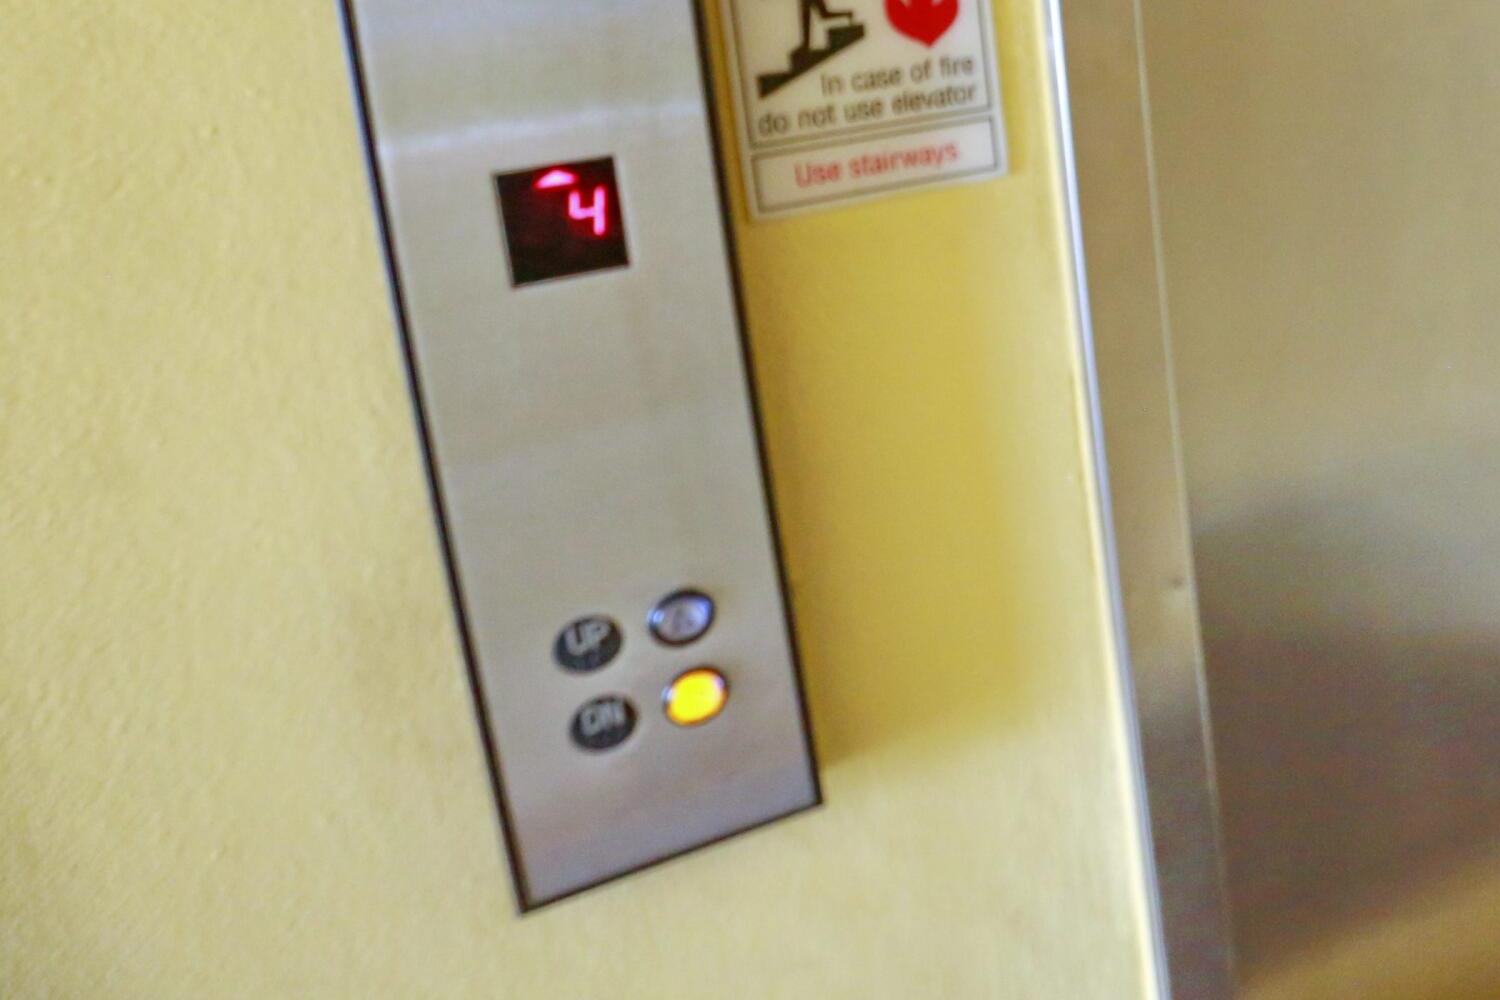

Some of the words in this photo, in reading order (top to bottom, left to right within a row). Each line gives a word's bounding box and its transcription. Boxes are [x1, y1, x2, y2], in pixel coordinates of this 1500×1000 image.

[820, 73, 842, 96] In
[852, 69, 902, 91] case
[910, 60, 934, 82] of
[939, 55, 974, 77] fire
[757, 112, 788, 136] do
[797, 105, 838, 128] not
[843, 98, 884, 121] use
[891, 84, 976, 113] elevator
[794, 163, 840, 188] Use
[849, 141, 959, 179] stairways
[568, 185, 606, 236] 4
[563, 618, 611, 656] UP
